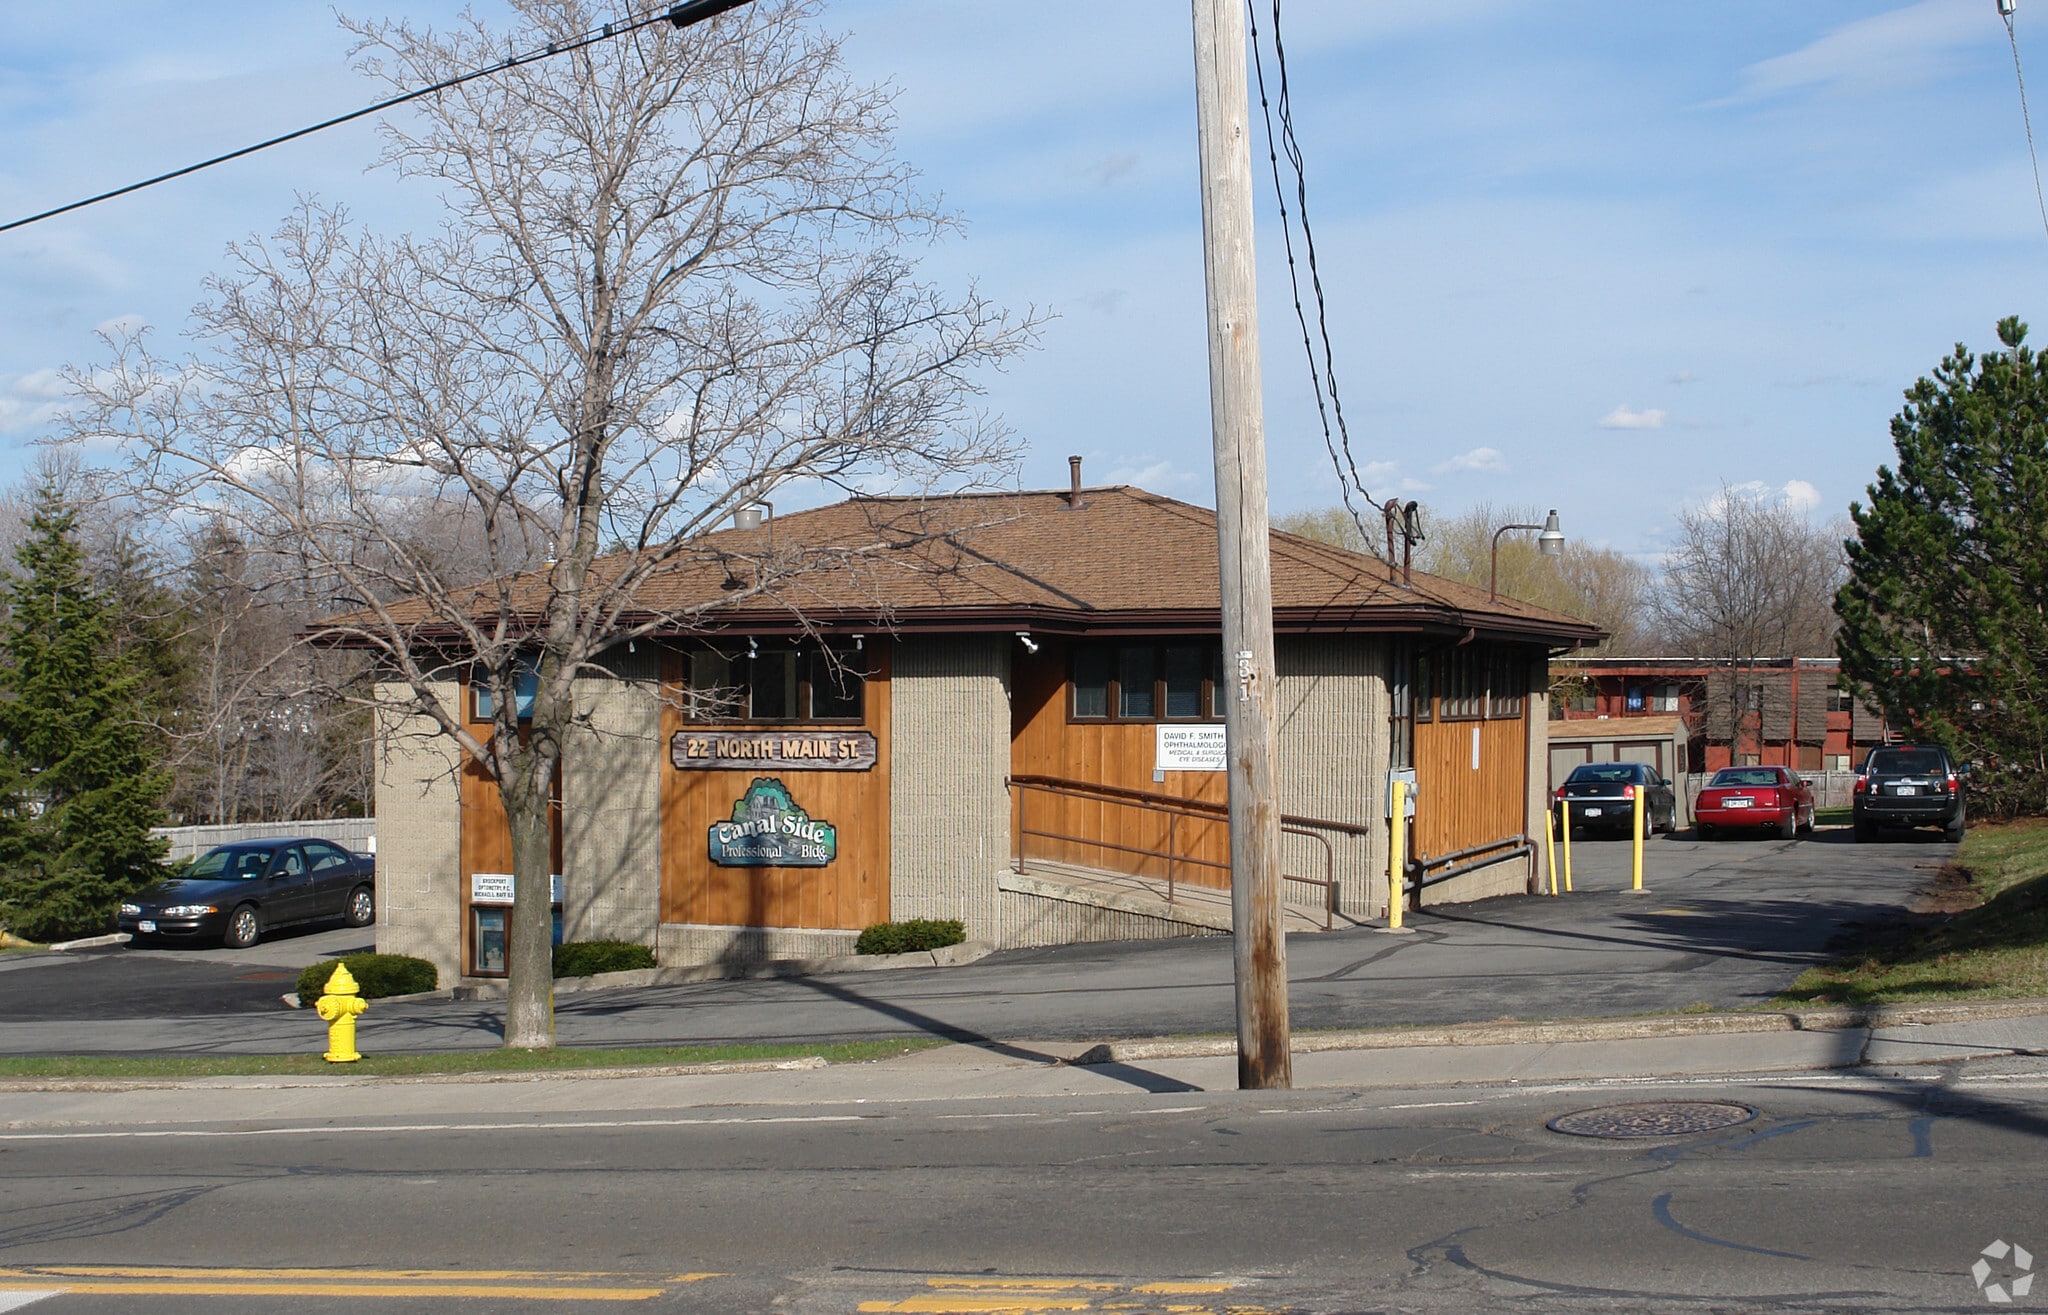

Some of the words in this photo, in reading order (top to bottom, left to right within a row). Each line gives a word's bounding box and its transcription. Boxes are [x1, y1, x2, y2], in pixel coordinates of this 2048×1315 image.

[1164, 732, 1187, 740] DAVID
[1190, 732, 1196, 740] F.
[1198, 732, 1224, 740] SMITH
[687, 739, 709, 758] 22
[716, 739, 773, 758] NORTH
[782, 739, 831, 758] MAIN
[838, 740, 860, 758] ST.
[719, 815, 776, 844] Canal
[782, 815, 825, 844] Side
[722, 845, 782, 858] Professional
[801, 845, 827, 861] Bldg.
